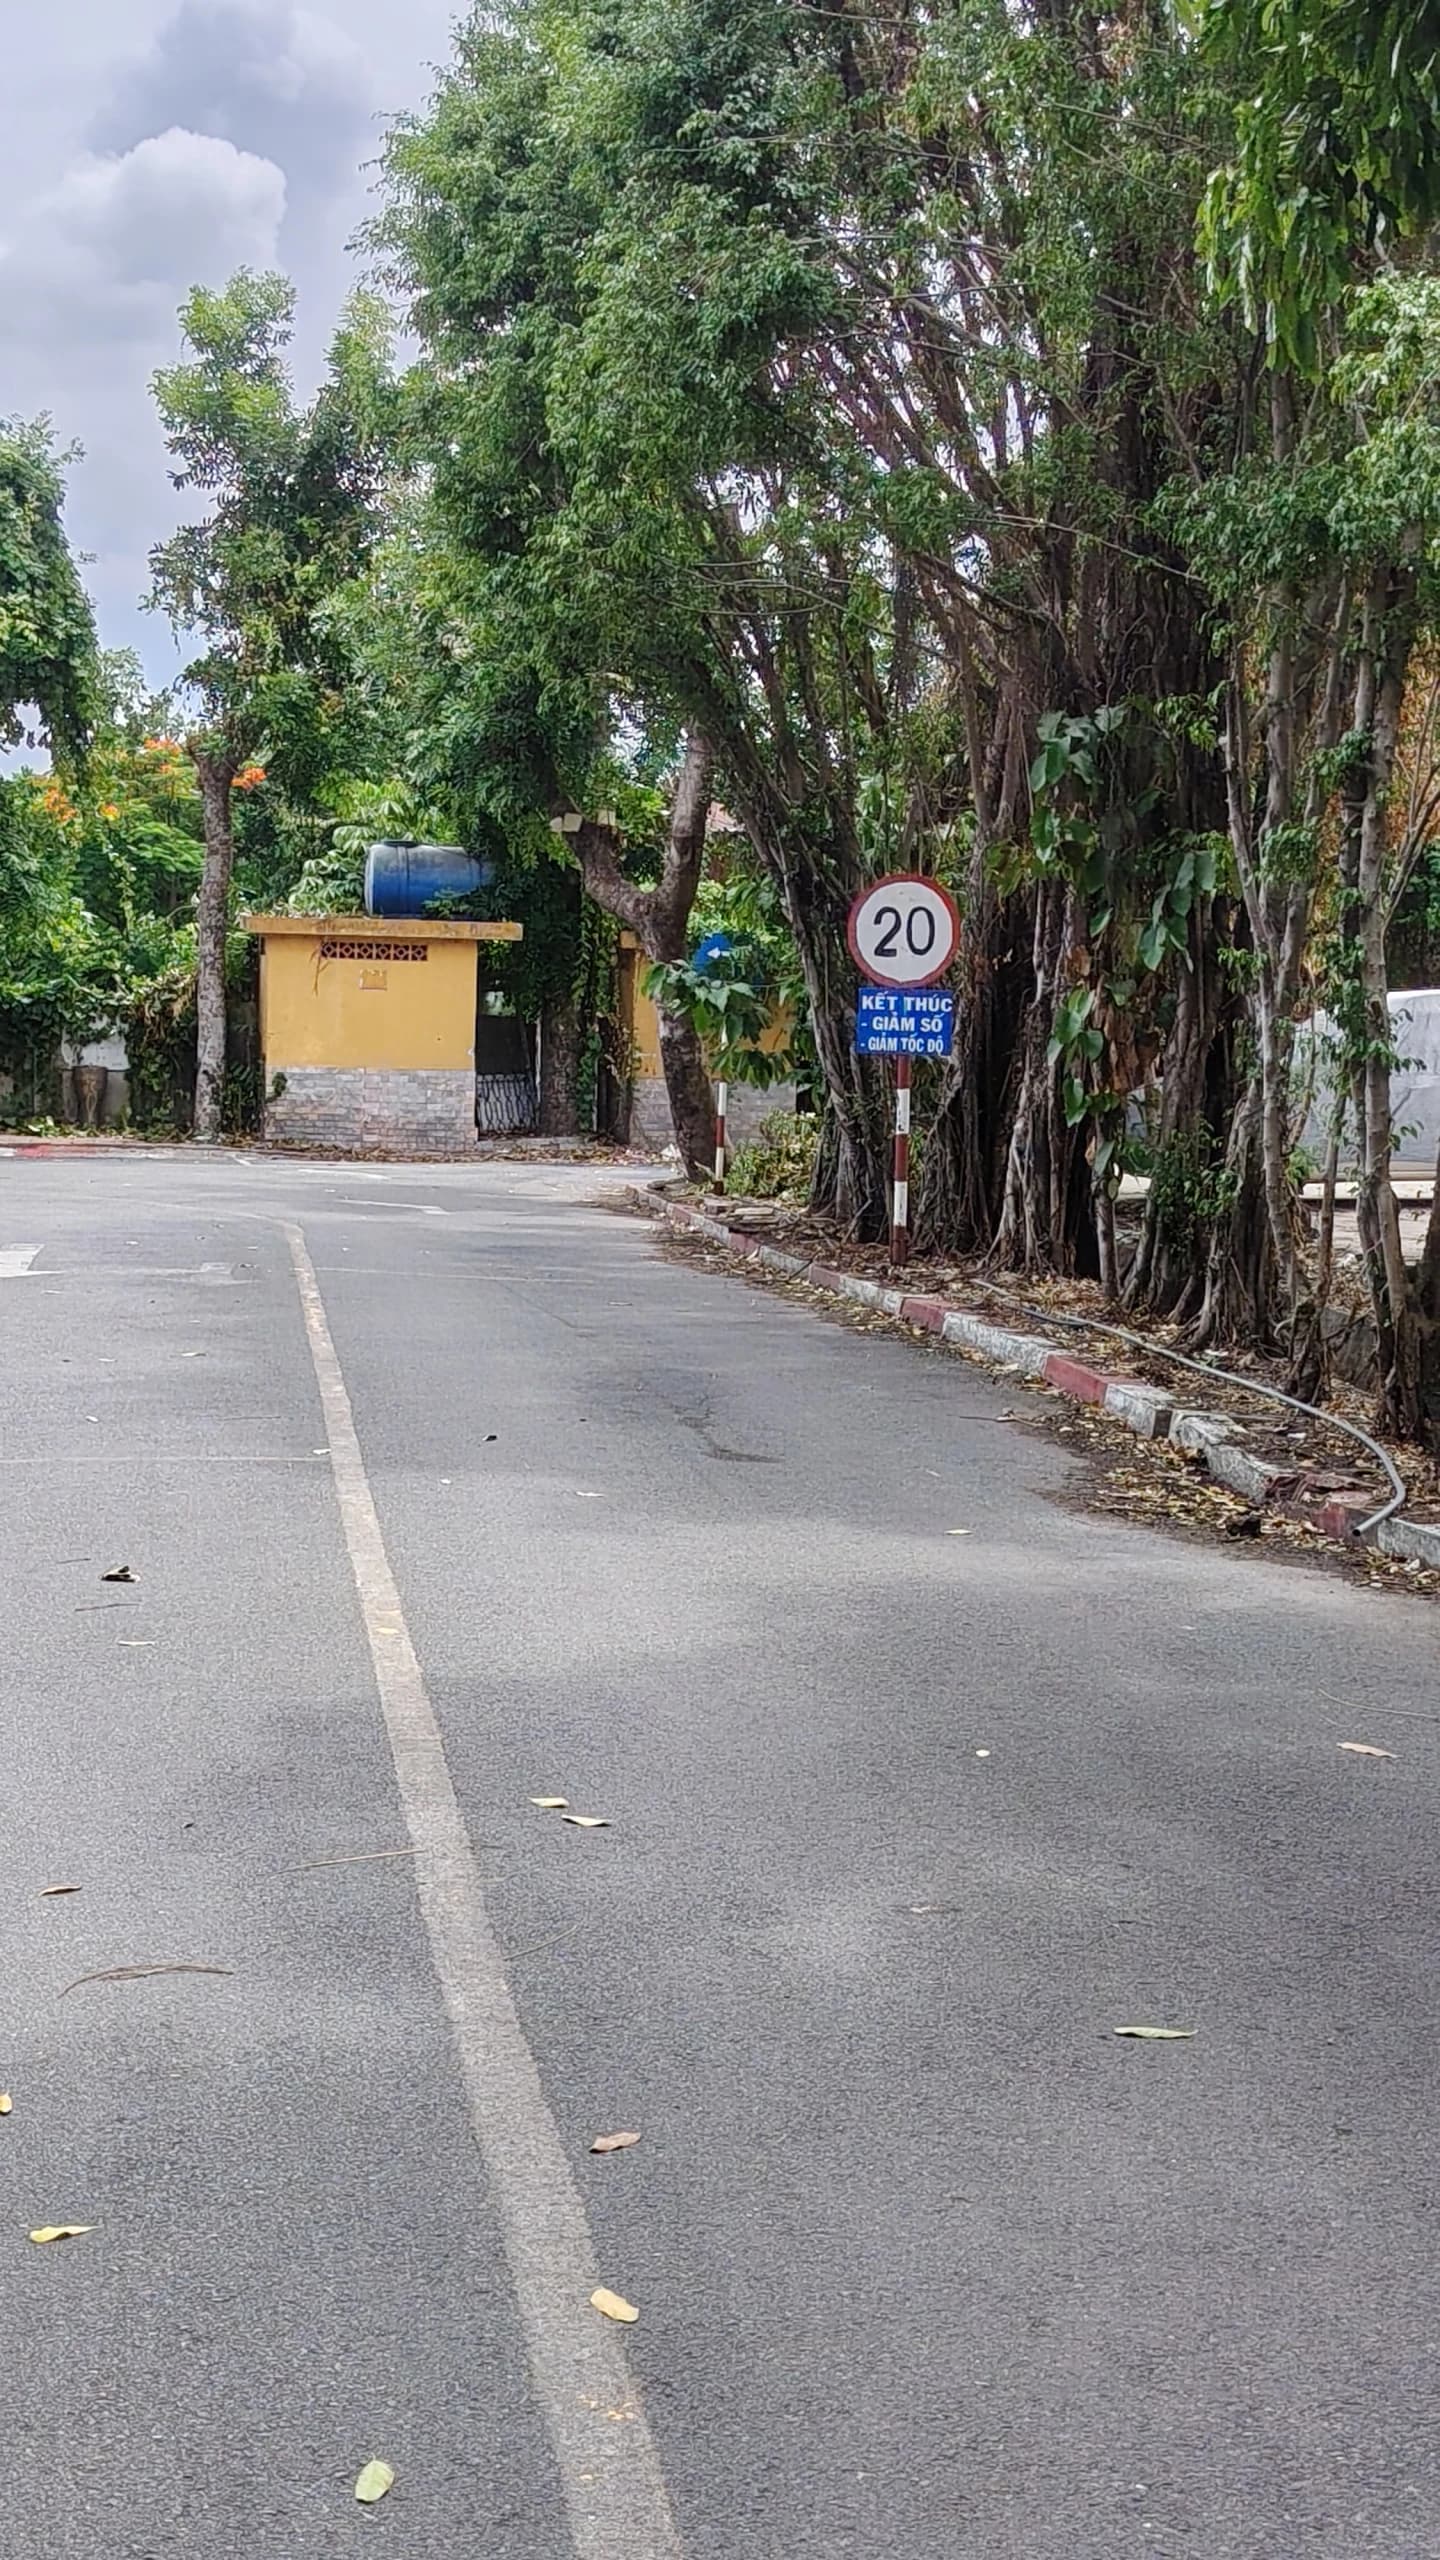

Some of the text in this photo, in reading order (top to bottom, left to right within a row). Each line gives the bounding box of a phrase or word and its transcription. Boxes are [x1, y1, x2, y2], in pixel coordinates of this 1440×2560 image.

[873, 905, 936, 958] 20
[861, 990, 953, 1013] KẾT THÚC
[920, 1013, 945, 1033] SỐ
[900, 1032, 925, 1053] TỐC
